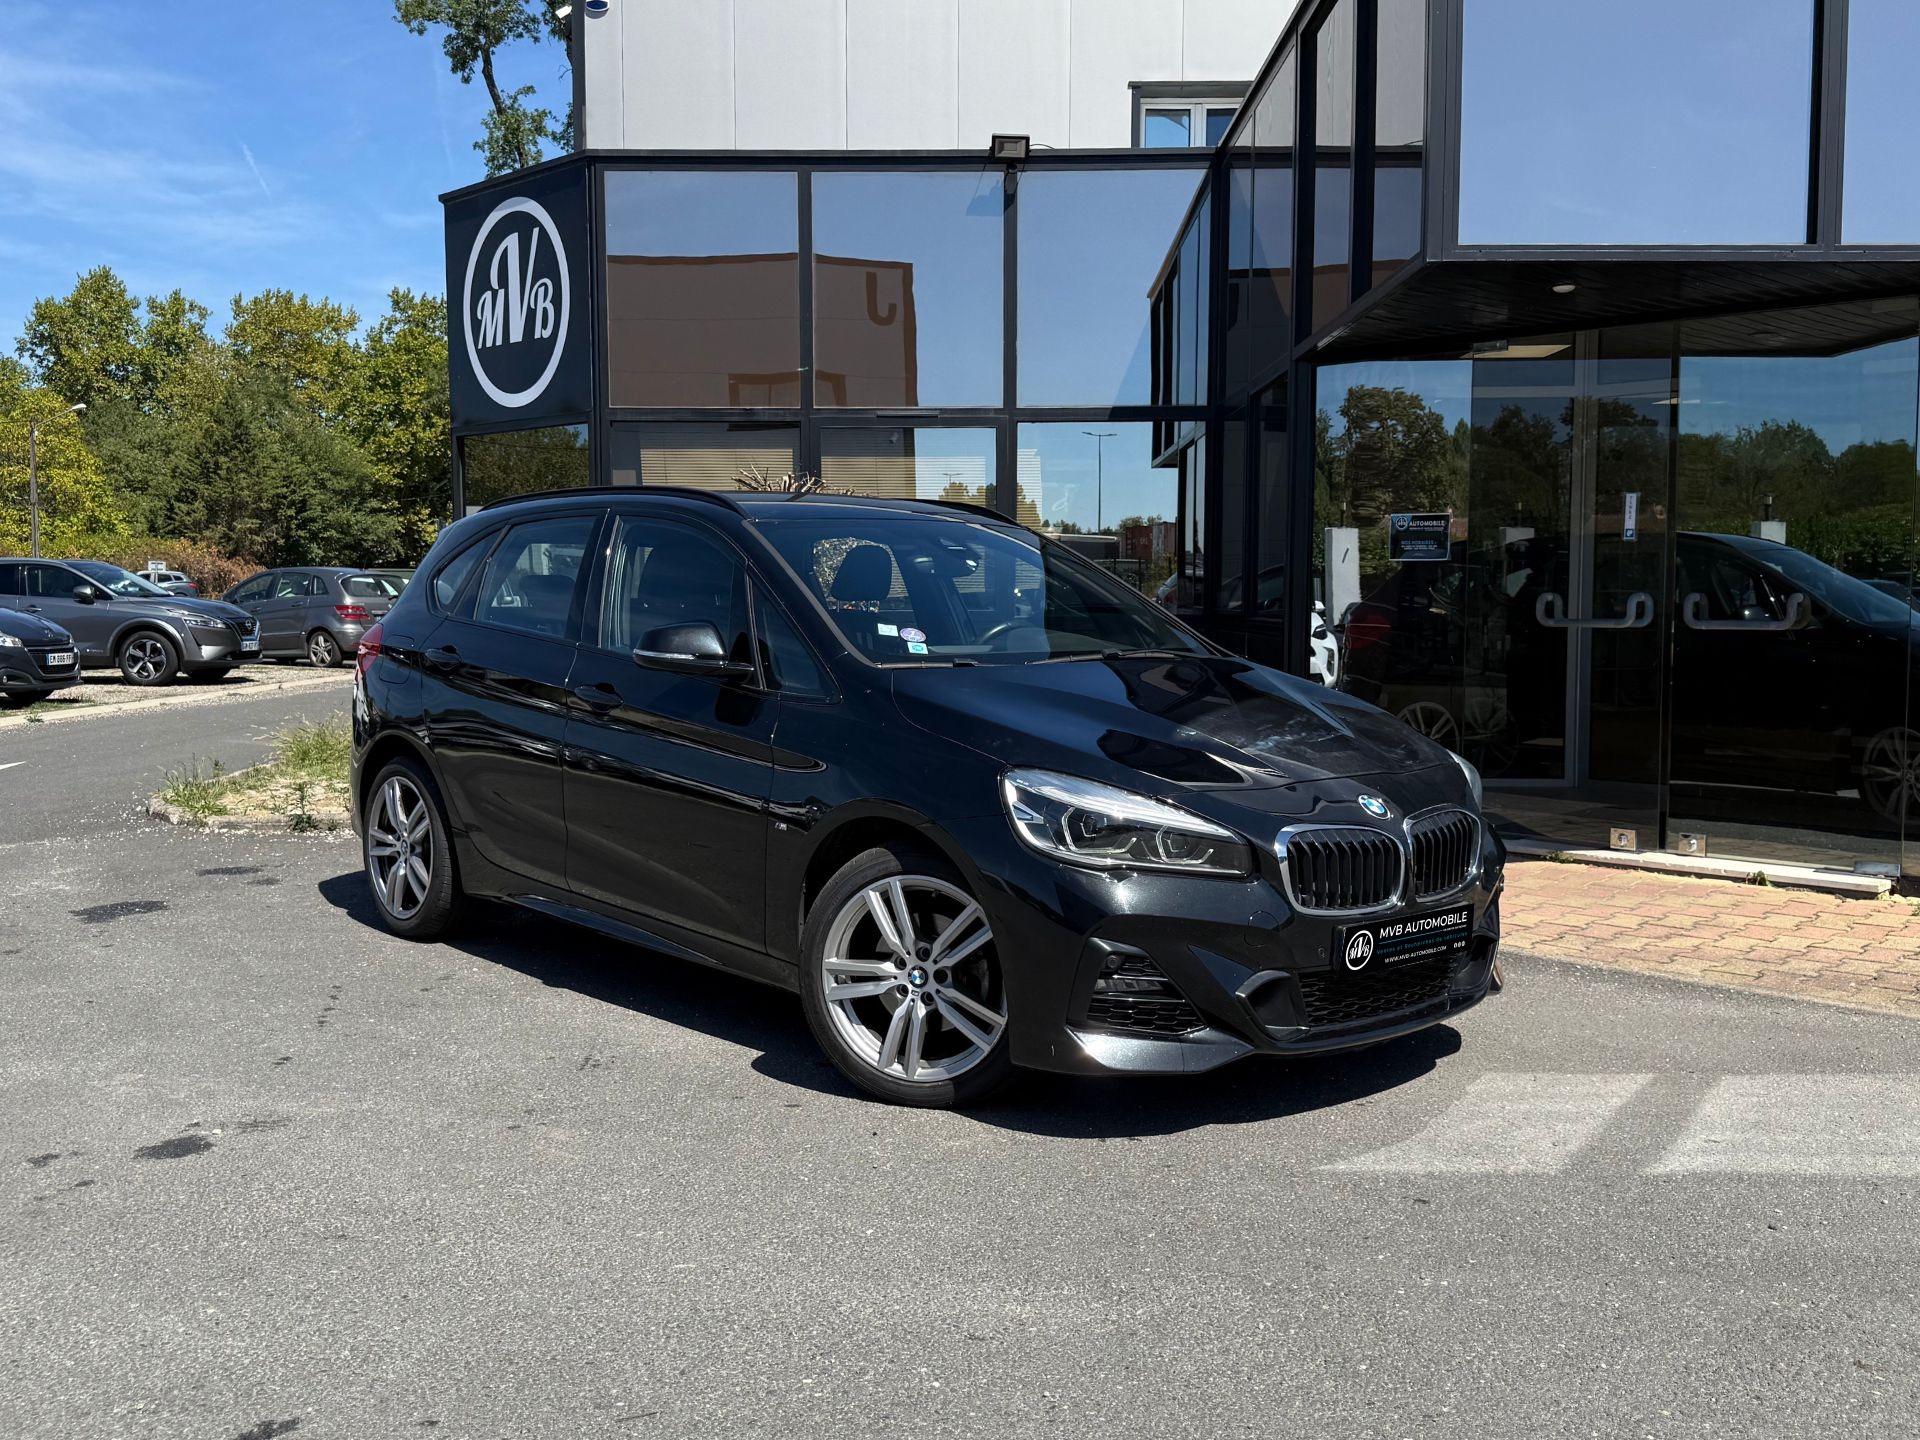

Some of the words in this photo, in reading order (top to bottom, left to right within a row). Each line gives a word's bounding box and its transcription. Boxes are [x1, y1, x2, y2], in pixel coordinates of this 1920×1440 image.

[477, 226, 555, 350] MVB
[1379, 924, 1403, 939] MVB
[1404, 911, 1468, 934] AUTOMOBILE
